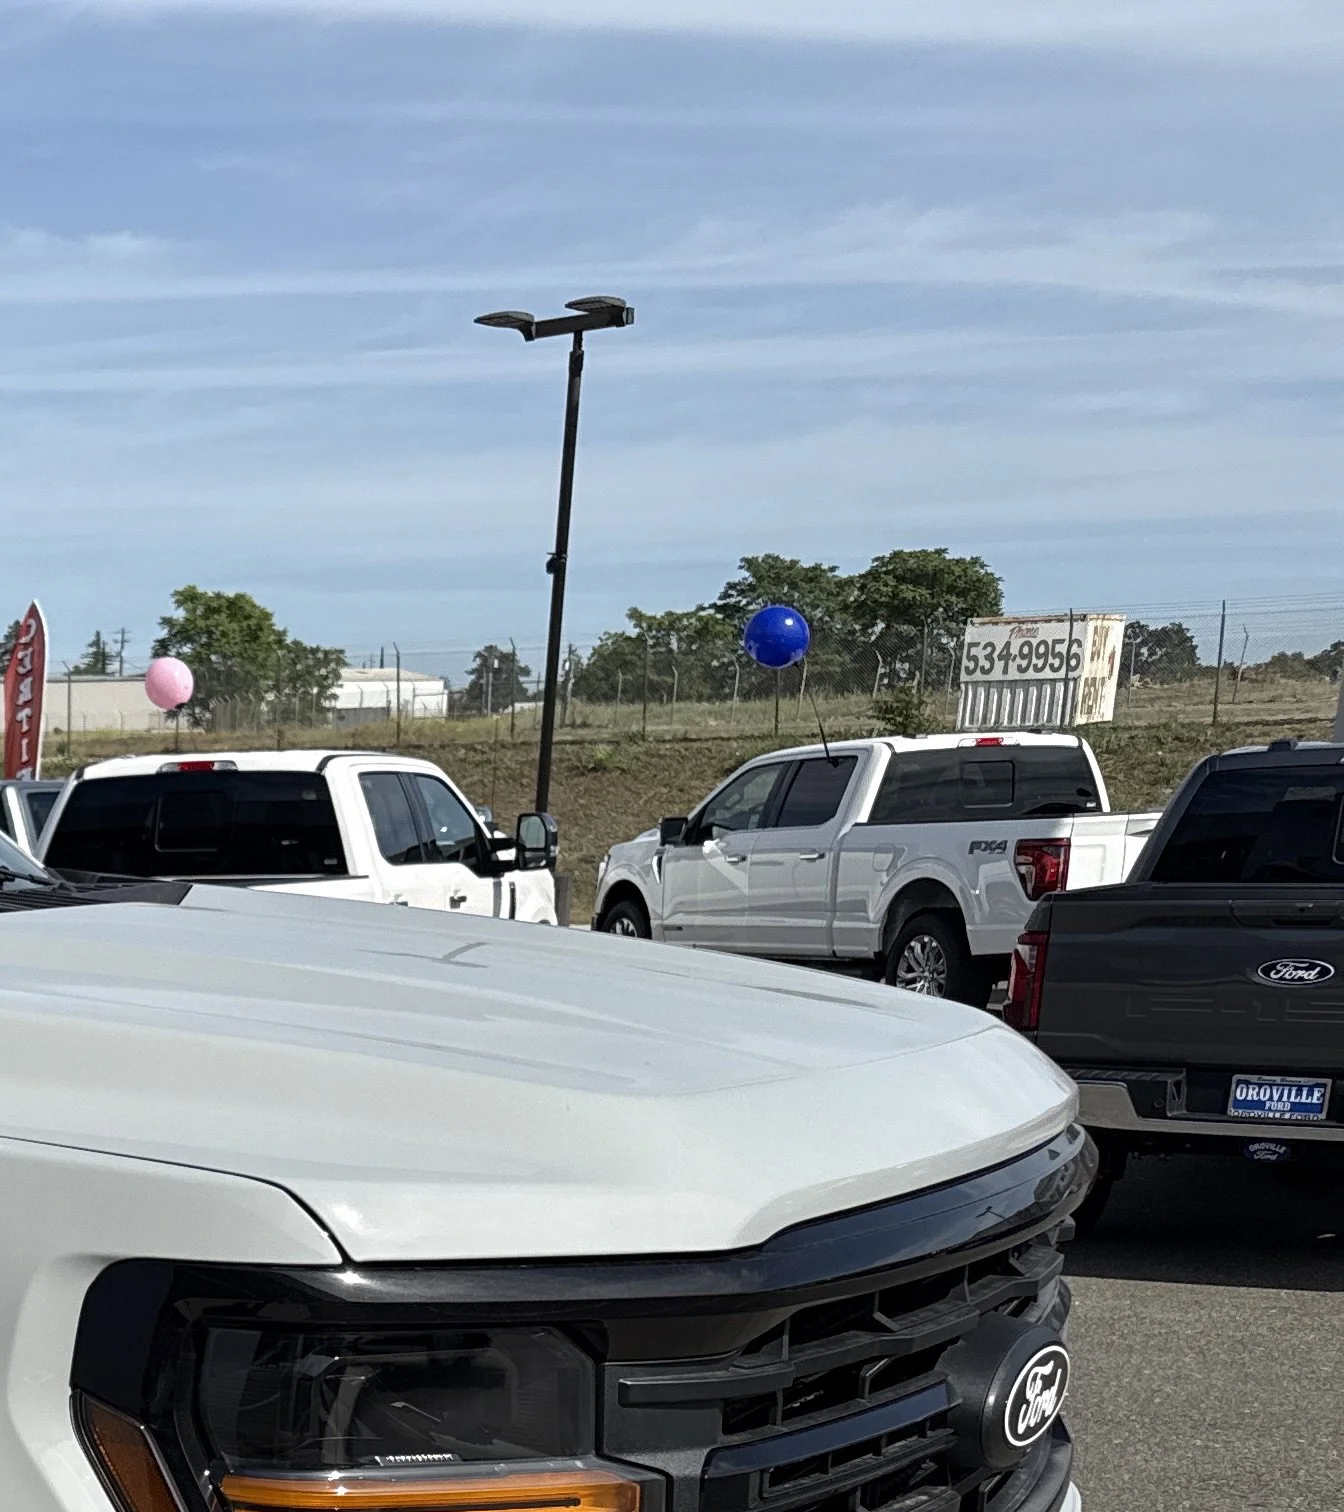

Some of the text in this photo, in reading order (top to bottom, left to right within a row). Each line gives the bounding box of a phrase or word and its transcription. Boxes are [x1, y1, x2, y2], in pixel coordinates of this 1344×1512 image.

[967, 839, 1009, 855] FX4
[1269, 961, 1322, 980] Ford
[1235, 1083, 1325, 1104] OROVILLE
[1264, 1101, 1292, 1111] FORD
[1017, 1360, 1062, 1434] Ford
